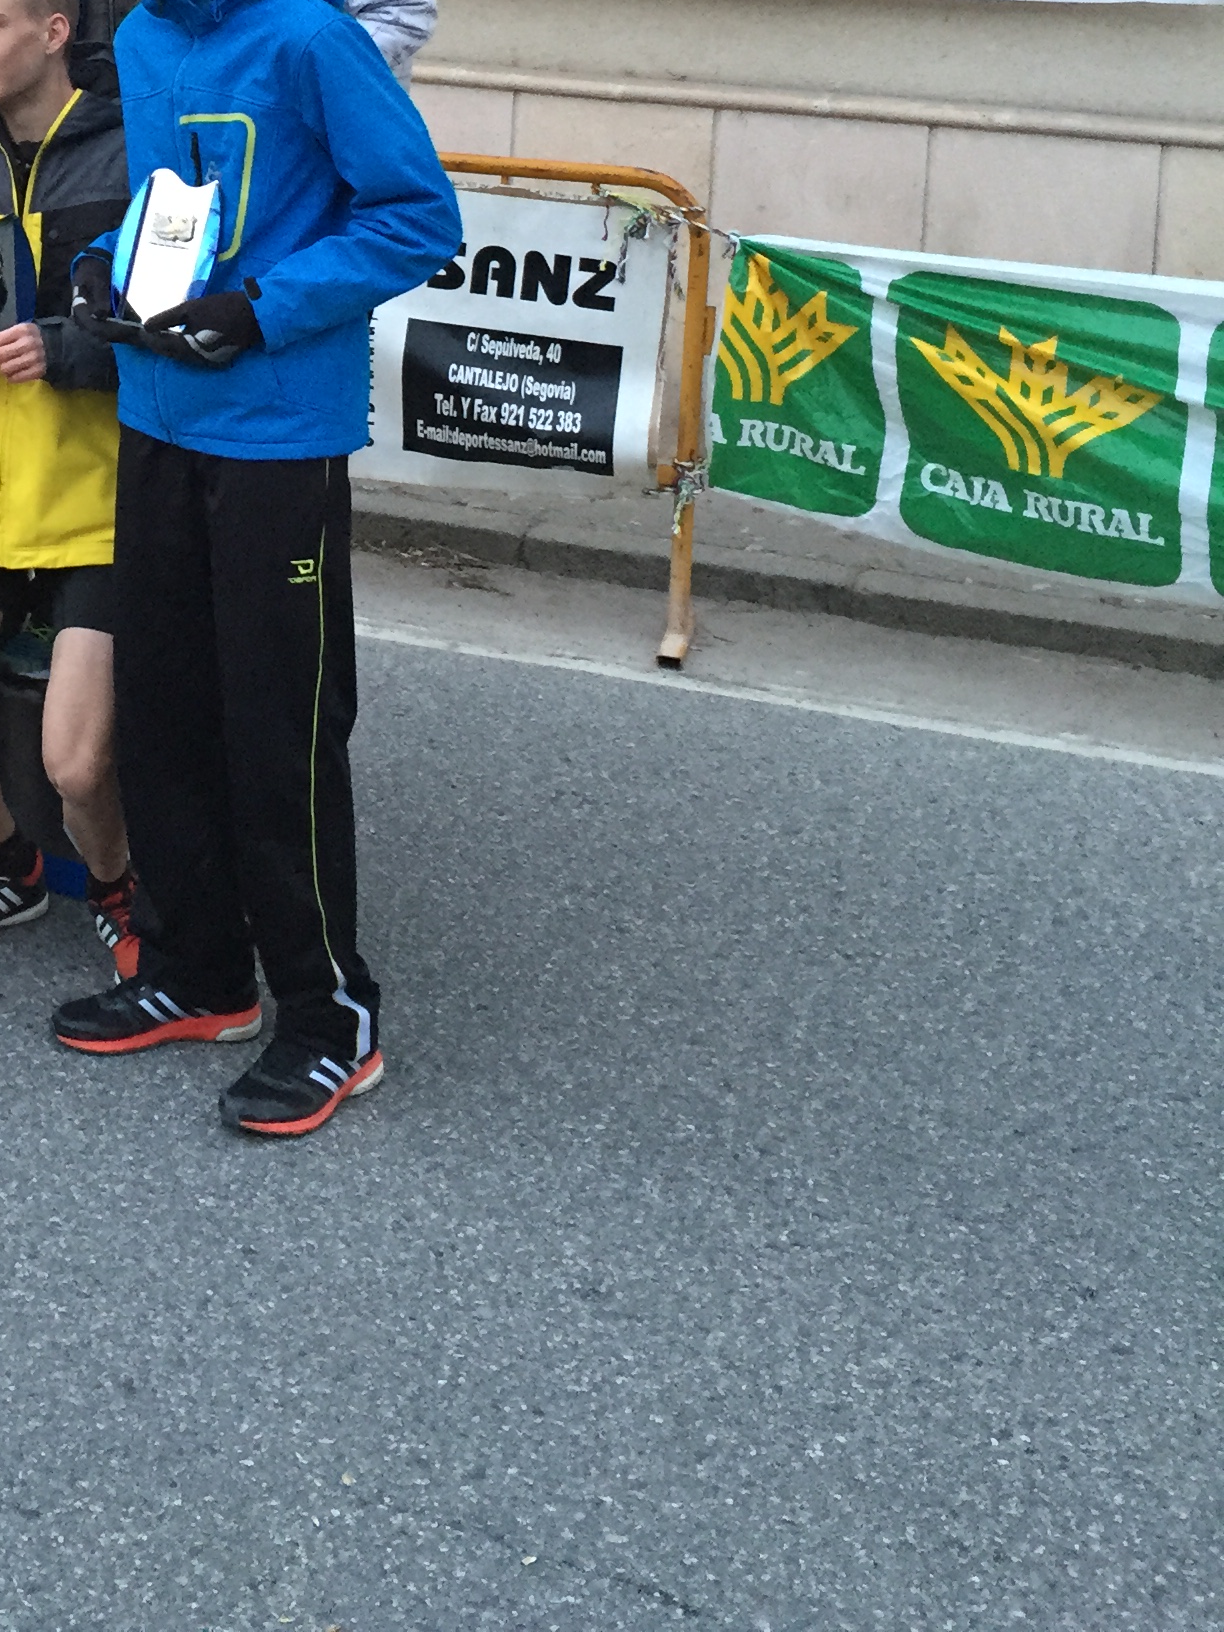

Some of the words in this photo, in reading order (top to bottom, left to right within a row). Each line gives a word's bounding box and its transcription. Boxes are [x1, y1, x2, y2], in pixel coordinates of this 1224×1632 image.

[466, 331, 479, 353] C/
[545, 342, 562, 365] 40
[448, 363, 519, 393] CANTALEJO
[520, 374, 576, 405] (Segovia)
[434, 393, 457, 417] Tel.
[461, 396, 471, 419] Y
[473, 398, 498, 424] Fax
[500, 402, 525, 427] 921
[527, 407, 553, 431] 522
[555, 410, 582, 434] 383
[736, 419, 866, 475] RURAL
[919, 462, 1013, 513] CAJA
[1023, 488, 1165, 547] RURAL
